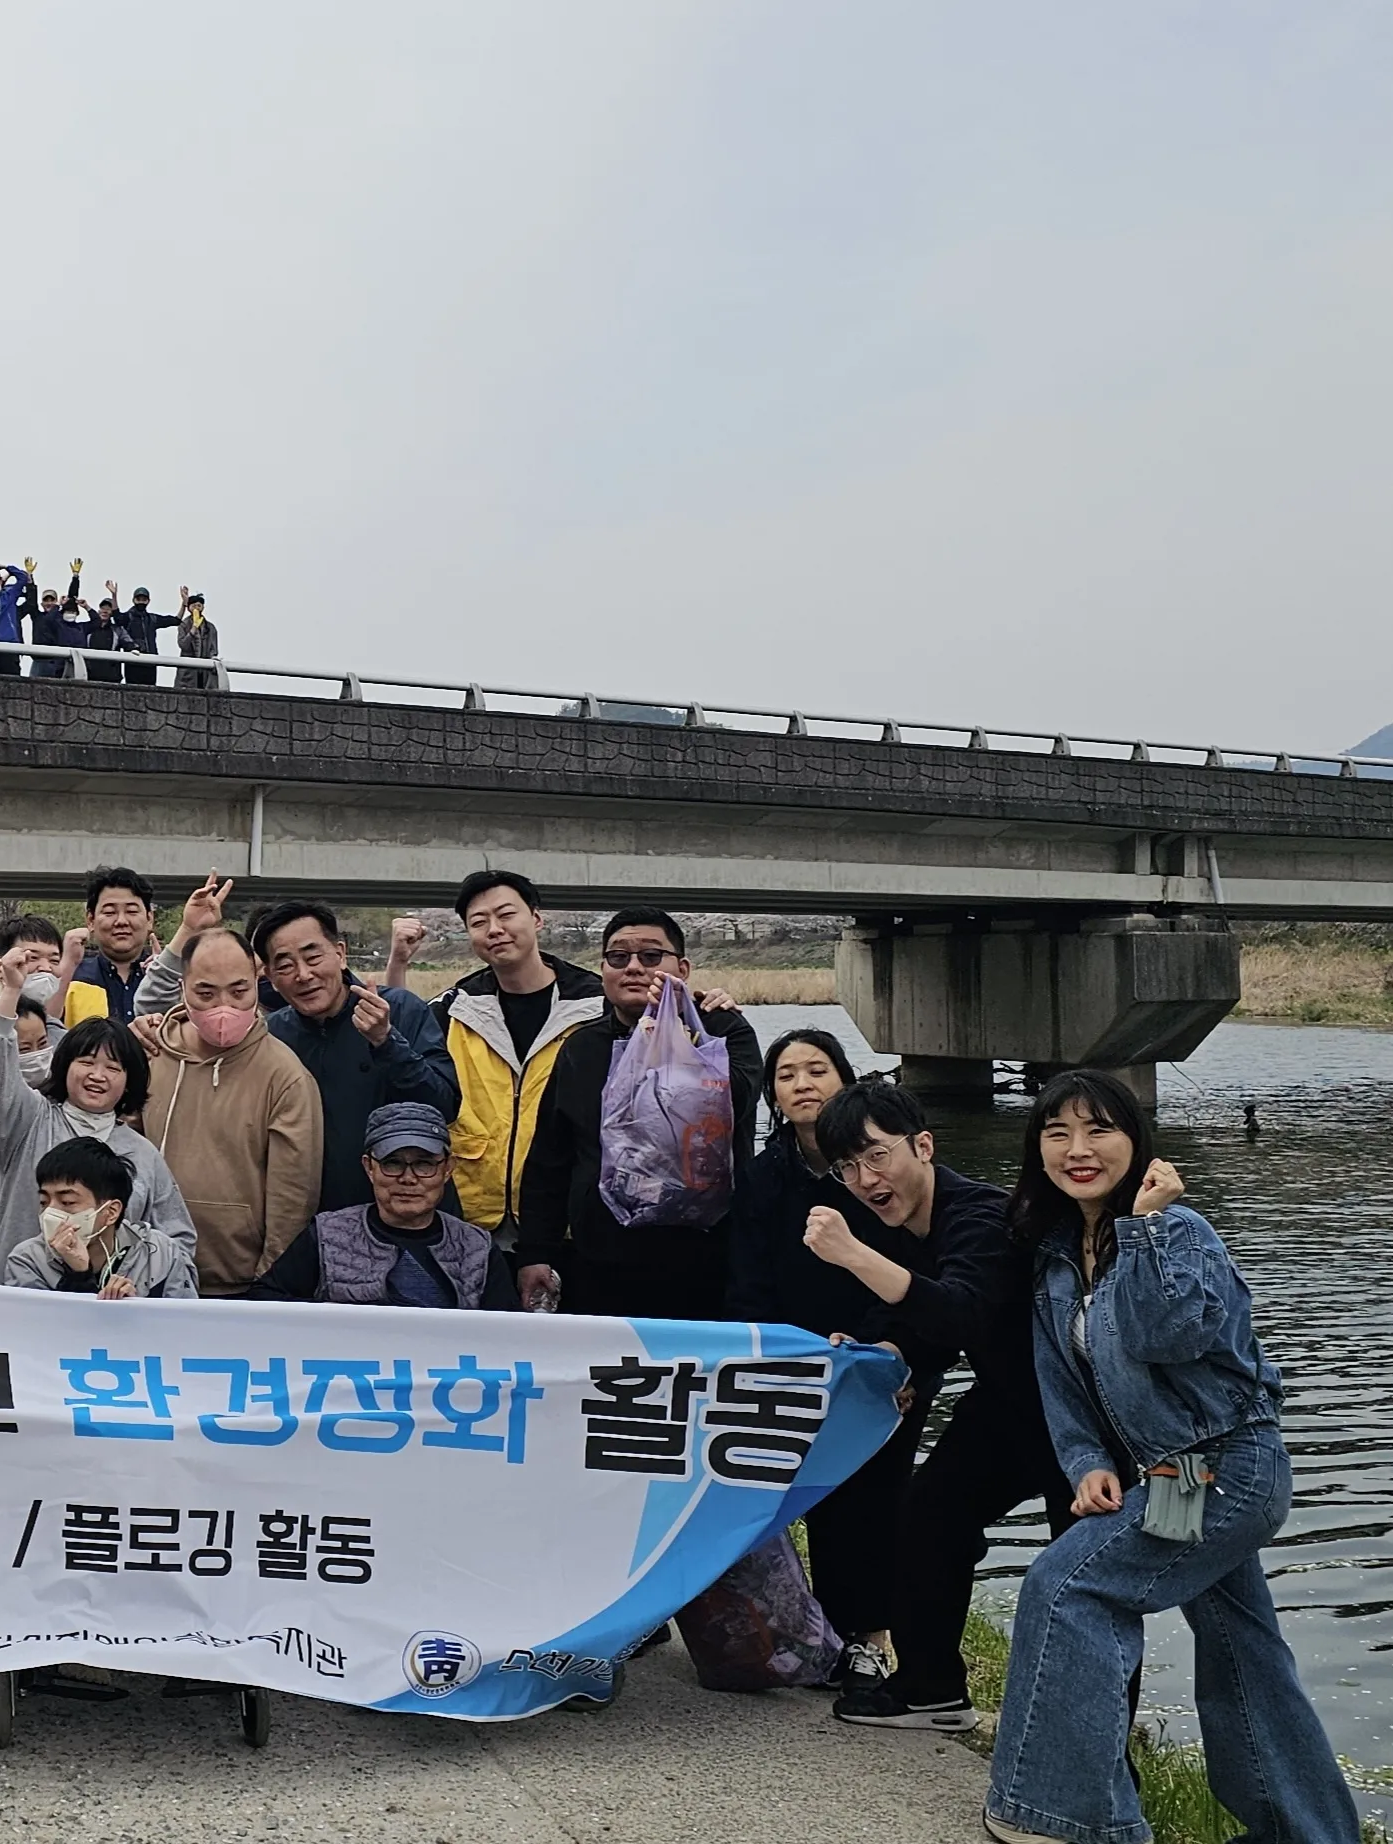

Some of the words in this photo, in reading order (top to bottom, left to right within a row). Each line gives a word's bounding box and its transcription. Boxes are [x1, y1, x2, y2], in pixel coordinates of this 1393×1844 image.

[59, 1348, 545, 1465] 환경정화
[580, 1355, 831, 1485] 활동
[60, 1503, 235, 1578] 플로깅
[255, 1508, 377, 1586] 활동
